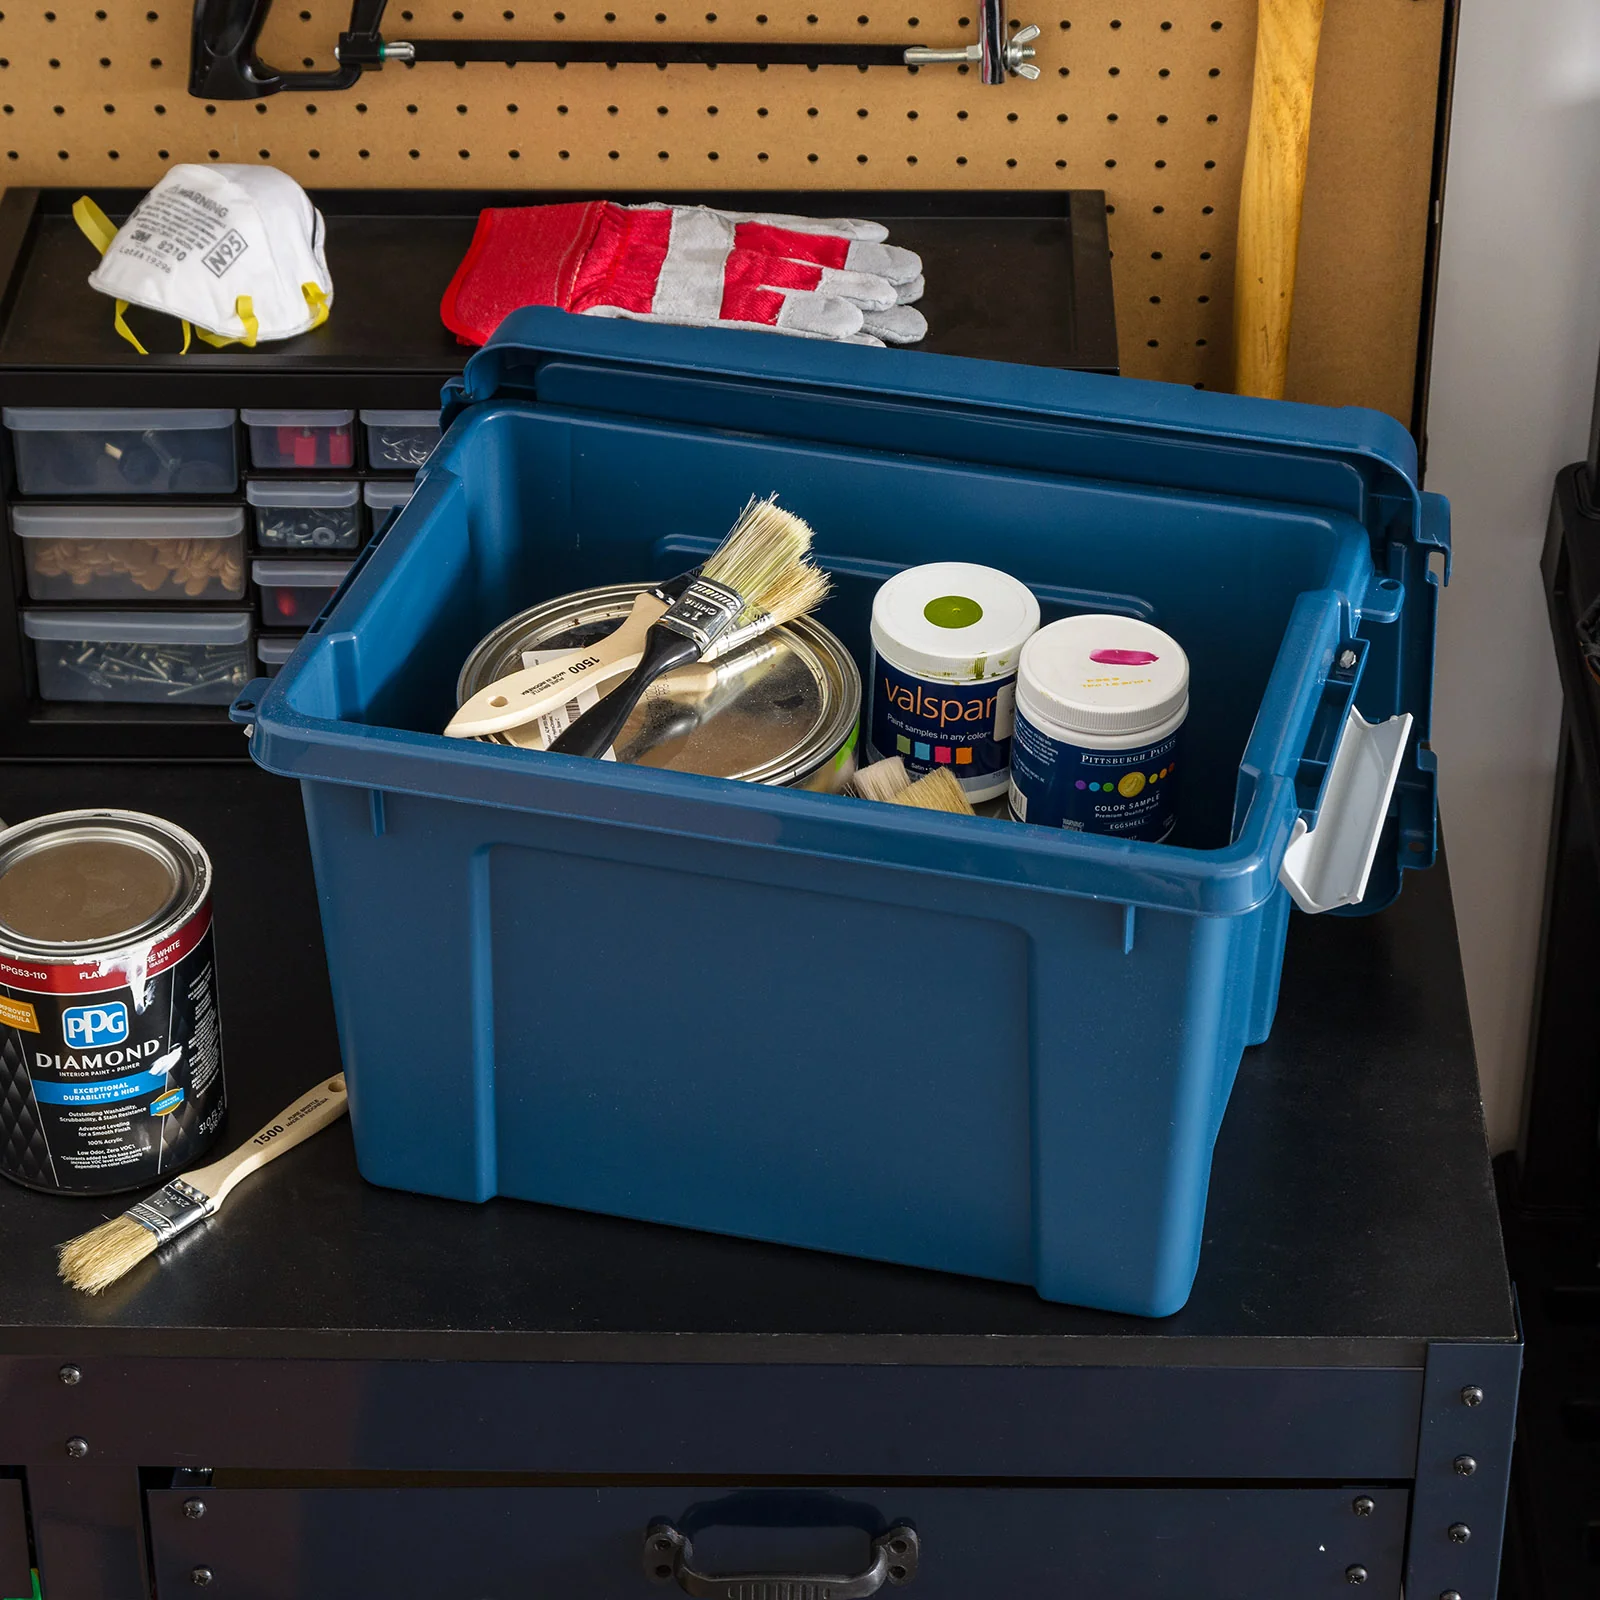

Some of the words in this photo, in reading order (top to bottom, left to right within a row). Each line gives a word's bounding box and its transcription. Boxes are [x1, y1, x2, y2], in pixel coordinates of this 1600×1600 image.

[178, 187, 229, 219] WARNING
[130, 229, 153, 244] 3M
[157, 239, 188, 262] 8210
[208, 235, 242, 273] N95
[568, 656, 600, 674] 1500
[552, 671, 566, 681] MADE
[520, 678, 546, 696] INDONESIA
[884, 677, 998, 728] valspar
[887, 712, 904, 729] Paint
[905, 723, 938, 739] samples
[940, 732, 949, 741] in
[950, 733, 965, 743] any
[1081, 751, 1146, 766] PITTSBURGH
[1150, 739, 1177, 758] PAINTS
[1094, 804, 1126, 813] COLOR
[1128, 793, 1160, 811] SAMPLE
[1124, 808, 1145, 819] Quality
[1148, 802, 1159, 812] Paint
[1109, 818, 1146, 831] EGGSHELL
[156, 938, 181, 960] WHITE
[1, 964, 48, 981] PPG53-110
[79, 970, 101, 981] FLA
[66, 1008, 125, 1044] PPG
[35, 1039, 160, 1070] DIAMOND
[90, 1068, 110, 1077] PAINT
[116, 1062, 140, 1073] PRIMER
[63, 1092, 111, 1101] DURABILITY
[113, 1090, 119, 1098] &
[120, 1085, 140, 1096] HIDE
[73, 1082, 129, 1094] EXCEPTIONAL
[59, 1116, 98, 1124] Scrubbability,
[103, 1113, 118, 1121] Stain
[118, 1106, 147, 1118] Resistance
[68, 1110, 103, 1119] Outstanding
[103, 1104, 137, 1115] Washability,
[78, 1124, 106, 1132] Advanced
[106, 1120, 131, 1130] Leveling
[285, 1116, 301, 1128] MADE
[92, 1129, 114, 1138] Smooth
[114, 1126, 132, 1135] Finish
[253, 1124, 285, 1146] 1500
[103, 1137, 123, 1147] Acrylic
[90, 1148, 106, 1157] Odor,
[106, 1147, 120, 1155] Zero
[102, 1157, 114, 1165] level
[114, 1152, 143, 1164] significantly
[107, 1152, 117, 1160] this
[117, 1150, 128, 1158] base
[128, 1148, 142, 1158] paint
[74, 1163, 100, 1171] depending
